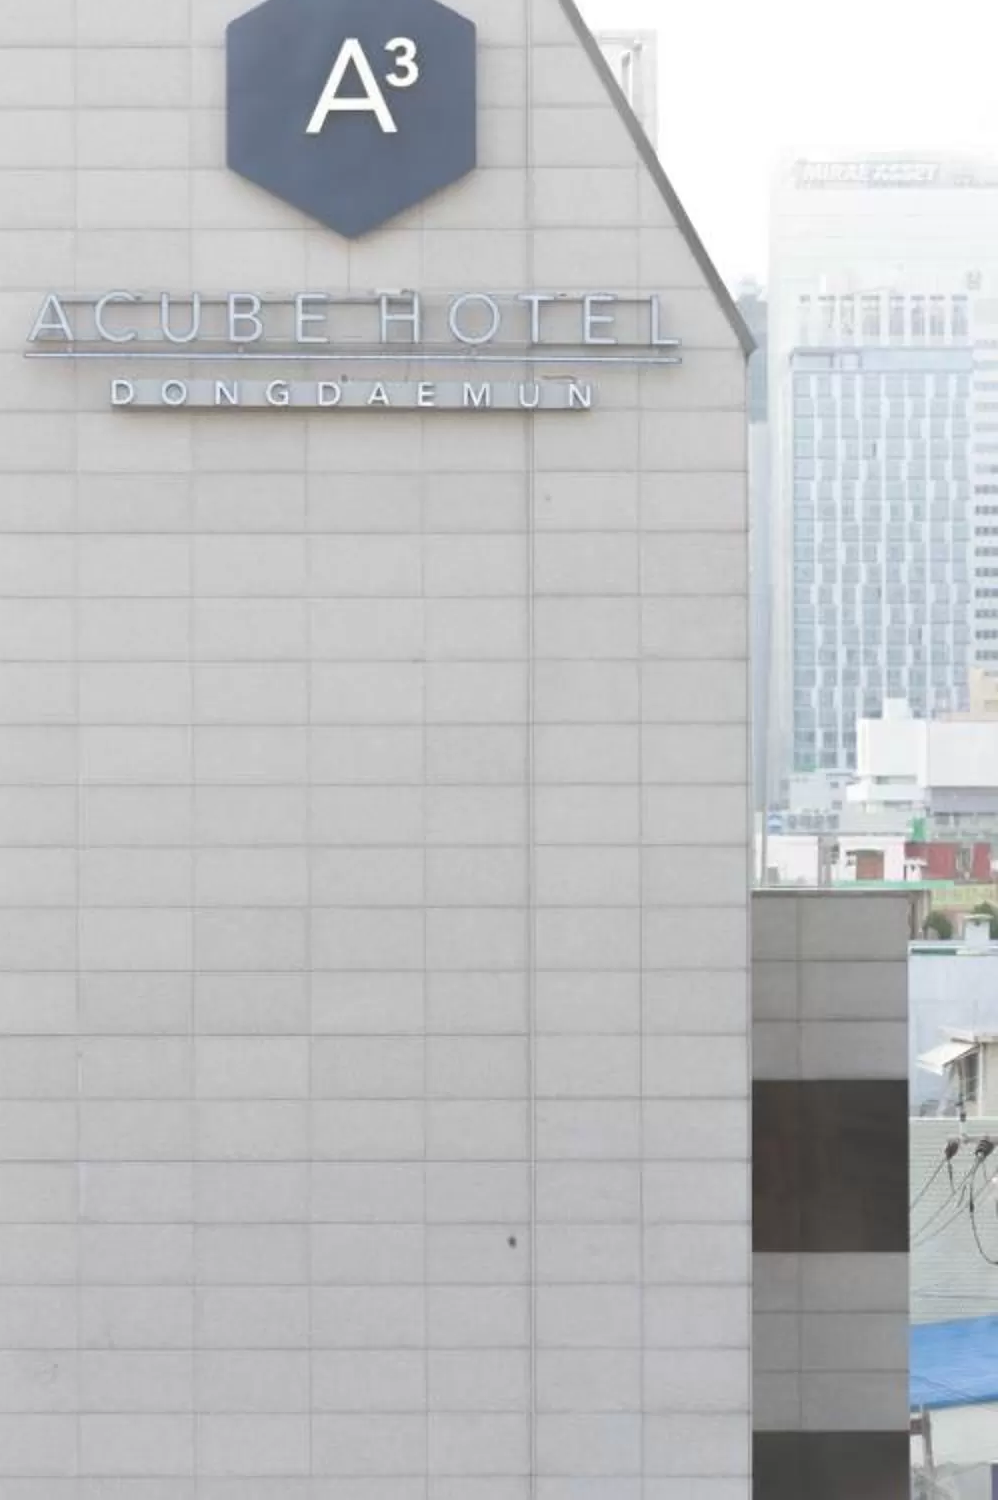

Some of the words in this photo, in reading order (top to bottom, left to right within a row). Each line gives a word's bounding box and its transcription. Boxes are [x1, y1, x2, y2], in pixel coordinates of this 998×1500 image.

[28, 290, 331, 344] ACUBE
[378, 292, 683, 346] HOTEL
[110, 378, 593, 407] DONGDAEMUN
